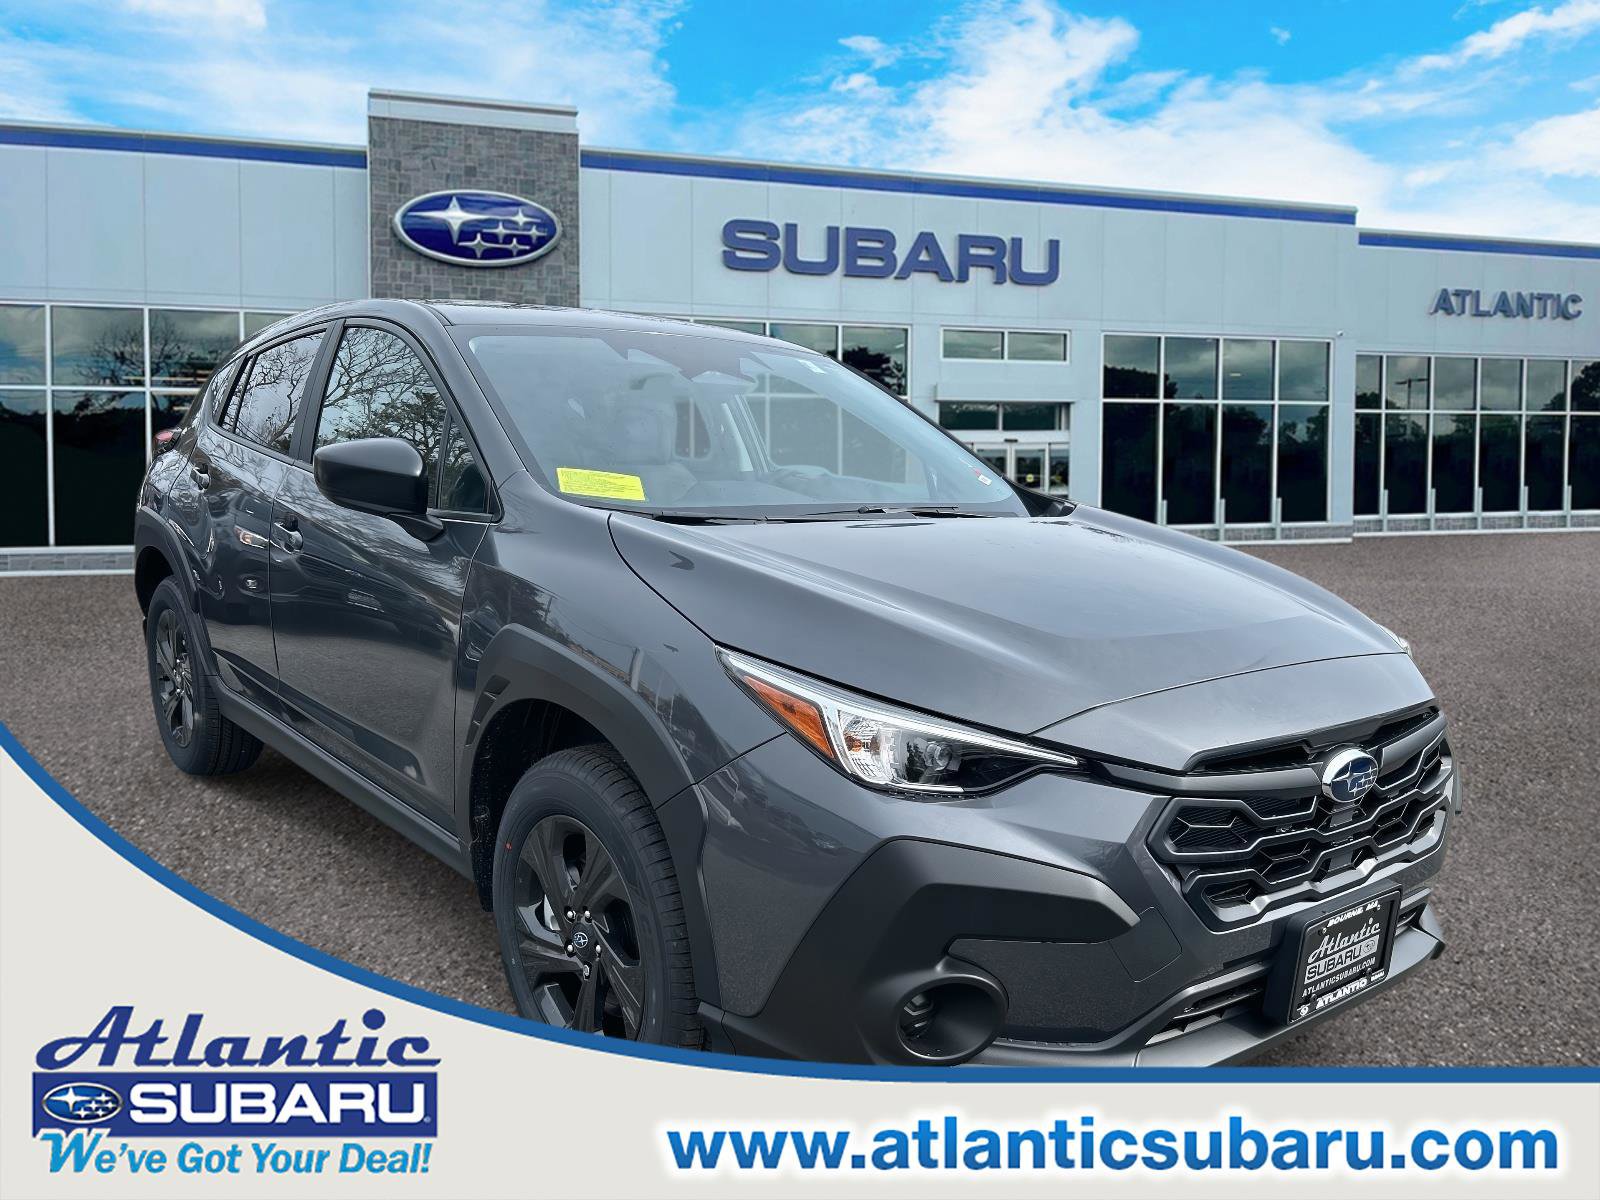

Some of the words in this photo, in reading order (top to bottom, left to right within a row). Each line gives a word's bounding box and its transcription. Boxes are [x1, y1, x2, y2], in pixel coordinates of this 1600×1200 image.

[722, 218, 1061, 286] SUBARU
[1429, 287, 1583, 320] ATLANTIC
[1307, 917, 1381, 964] Atlantic
[1301, 956, 1376, 998] ATLANTICSUBARU.COM
[1306, 947, 1363, 981] SUBARU
